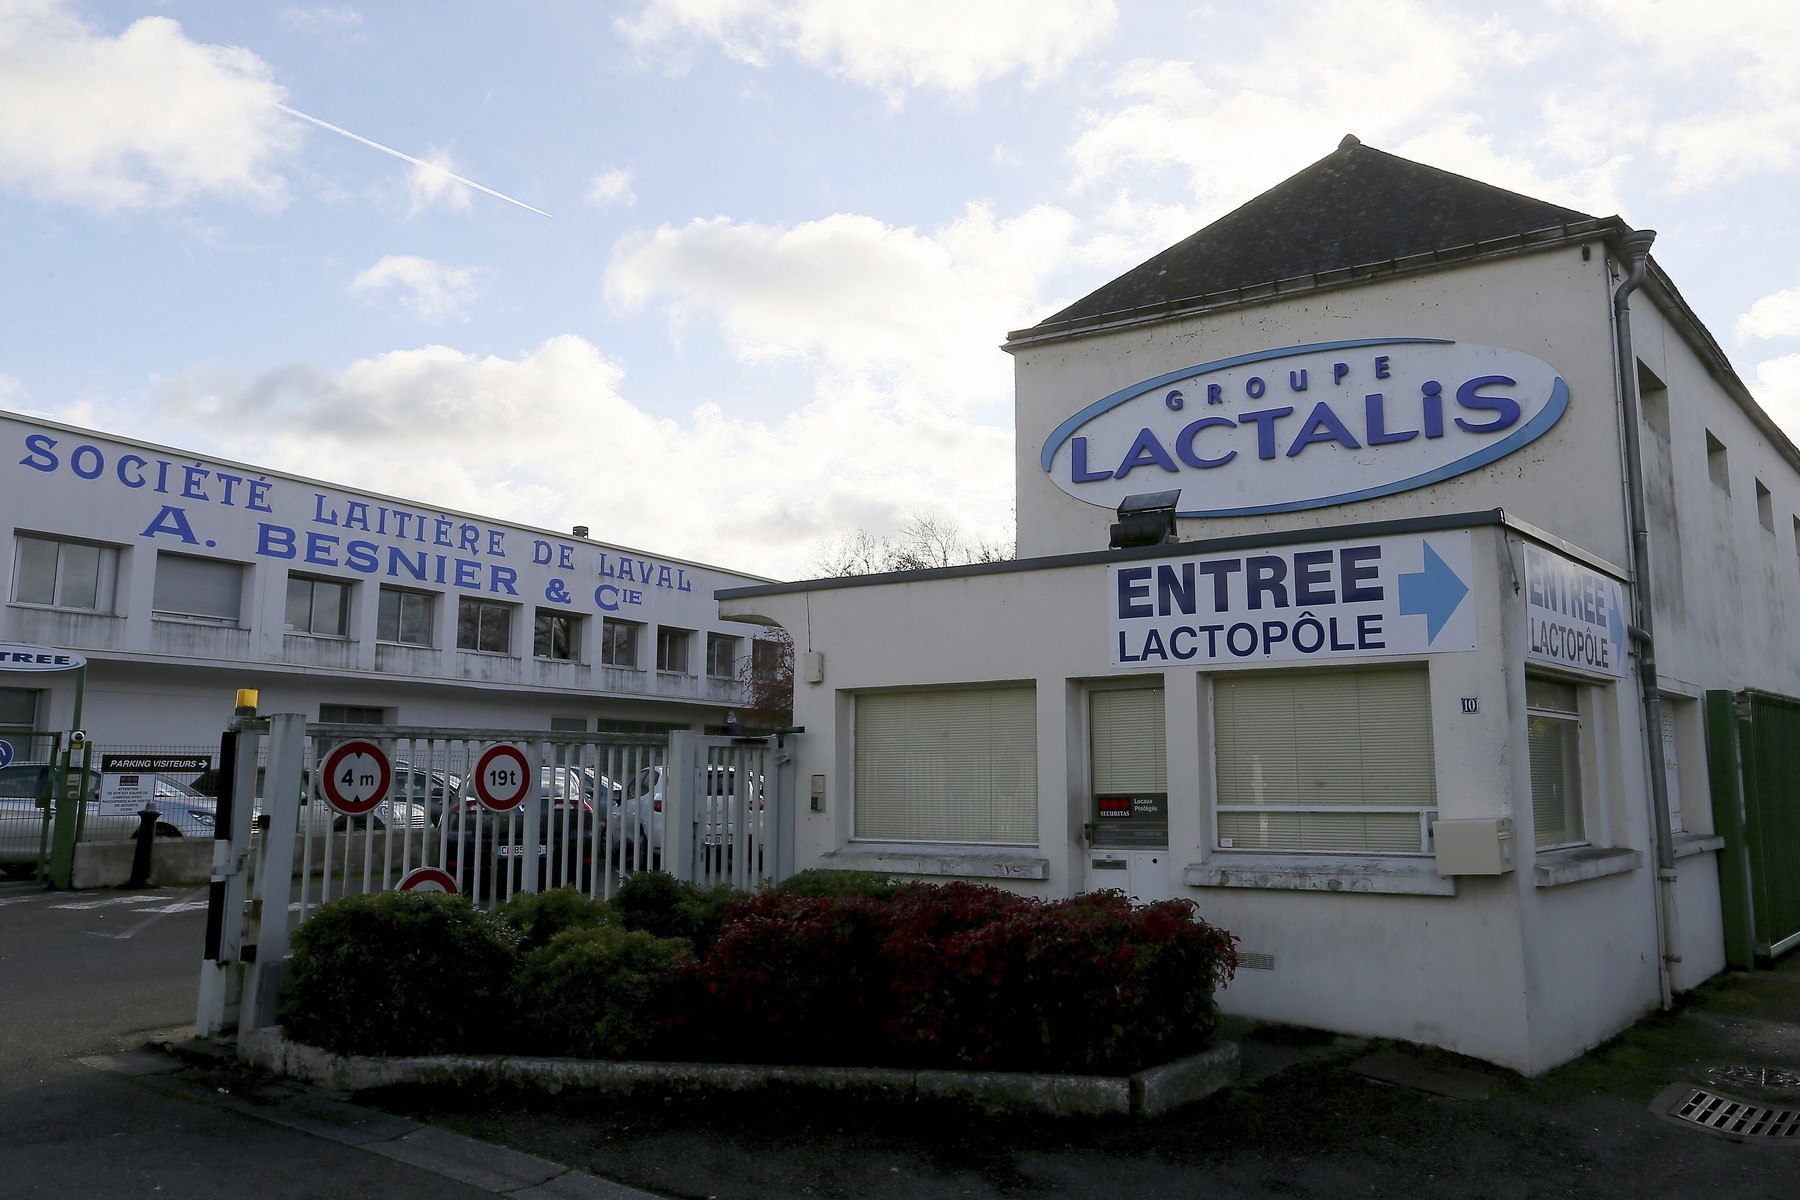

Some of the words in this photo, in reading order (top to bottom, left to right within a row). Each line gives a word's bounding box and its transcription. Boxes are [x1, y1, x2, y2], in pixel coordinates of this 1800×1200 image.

[1165, 355, 1392, 411] GROUPE
[19, 434, 273, 513] SOCIÉTÉ
[313, 493, 506, 557] LAITIÈRE
[533, 540, 575, 571] DE
[599, 552, 692, 592] LAVAL
[139, 505, 217, 547] A.
[255, 522, 519, 596] BESNIER
[545, 578, 572, 604] &
[1117, 544, 1385, 620] ENTREE
[1527, 549, 1607, 628] ENTREE
[1118, 611, 1386, 663] LACTOPÔLE
[1531, 617, 1609, 668] LACTOPÔLE
[1464, 699, 1476, 712] 10
[110, 760, 151, 768] PARKING
[153, 760, 196, 768] VISITEURS
[341, 769, 353, 786] 4
[360, 775, 374, 786] m
